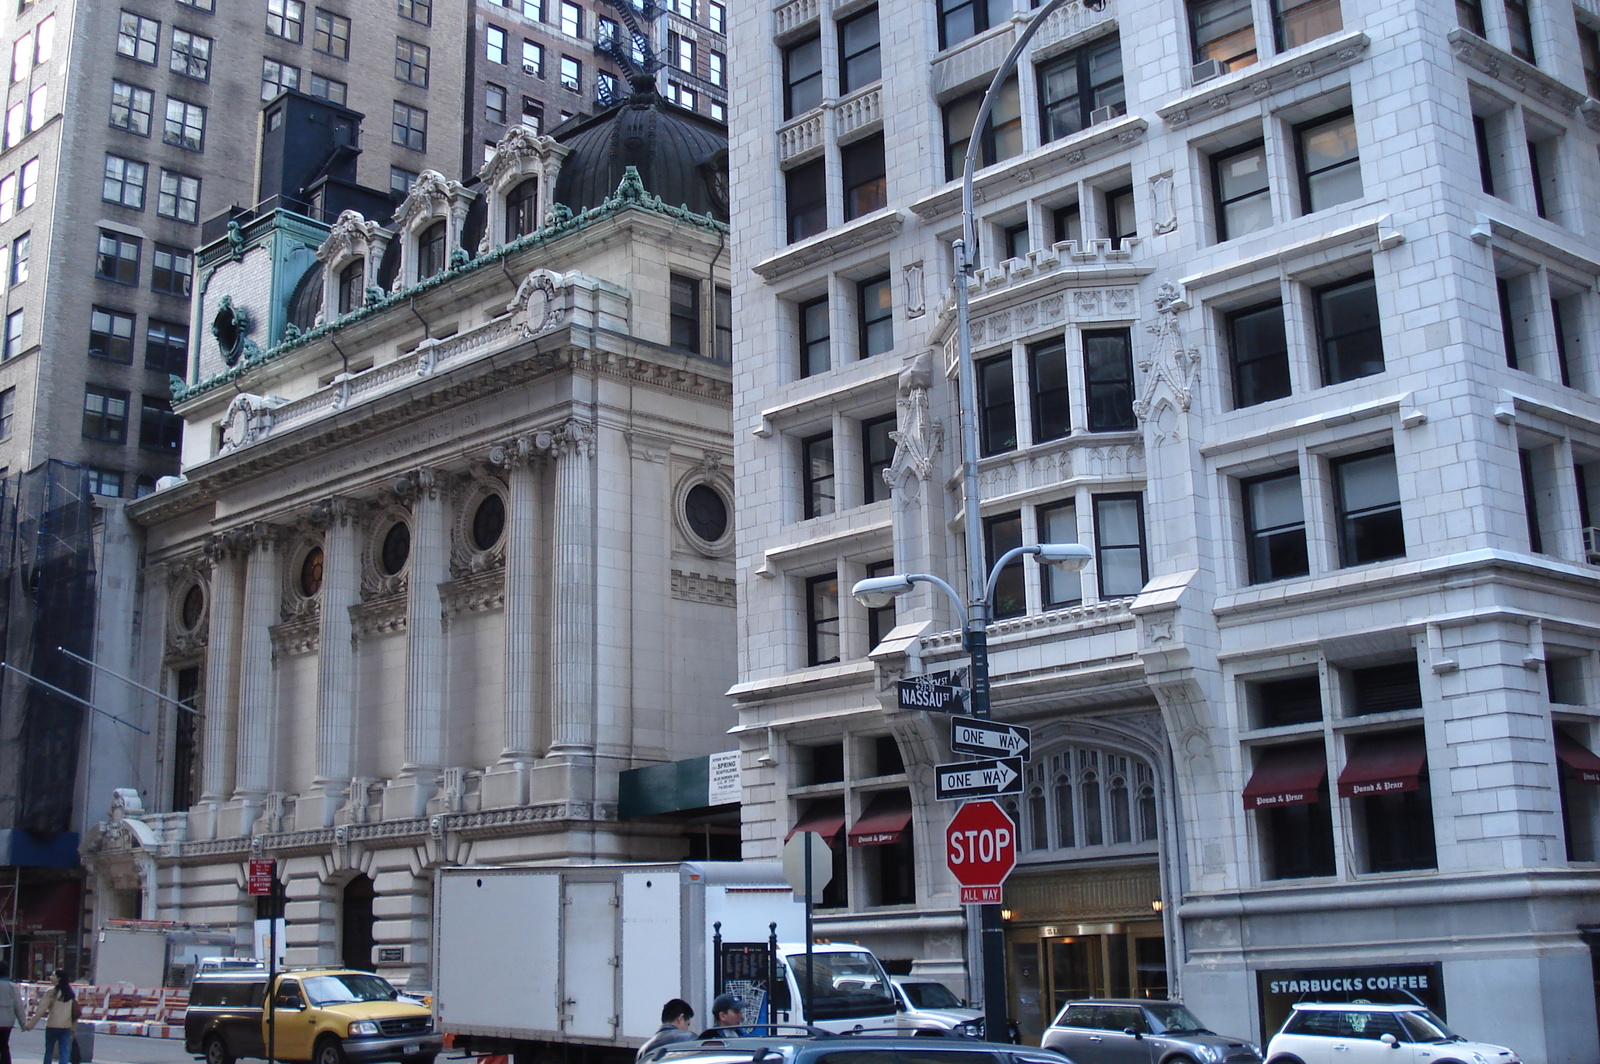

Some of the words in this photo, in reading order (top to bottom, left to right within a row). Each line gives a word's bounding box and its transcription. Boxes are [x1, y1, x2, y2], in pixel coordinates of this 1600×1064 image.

[364, 447, 379, 463] OF
[385, 422, 450, 455] COMMERCE
[942, 677, 948, 685] ST
[902, 688, 943, 708] NASSAU
[943, 693, 950, 702] ST
[963, 729, 984, 744] ONE
[999, 734, 1021, 750] WAY
[717, 761, 736, 769] SPRING
[947, 773, 972, 788] ONE
[983, 769, 1008, 784] WAY
[1353, 784, 1374, 794] Pound
[1375, 782, 1382, 791] &
[1256, 796, 1277, 806] Pound
[1277, 794, 1284, 803] &
[1285, 793, 1304, 802] Pence
[873, 834, 878, 842] &
[950, 828, 1010, 865] STOP
[963, 889, 978, 901] ALL
[982, 888, 998, 901] WAY
[1270, 977, 1363, 993] STARBUCKS
[1367, 975, 1428, 990] COFFEE
